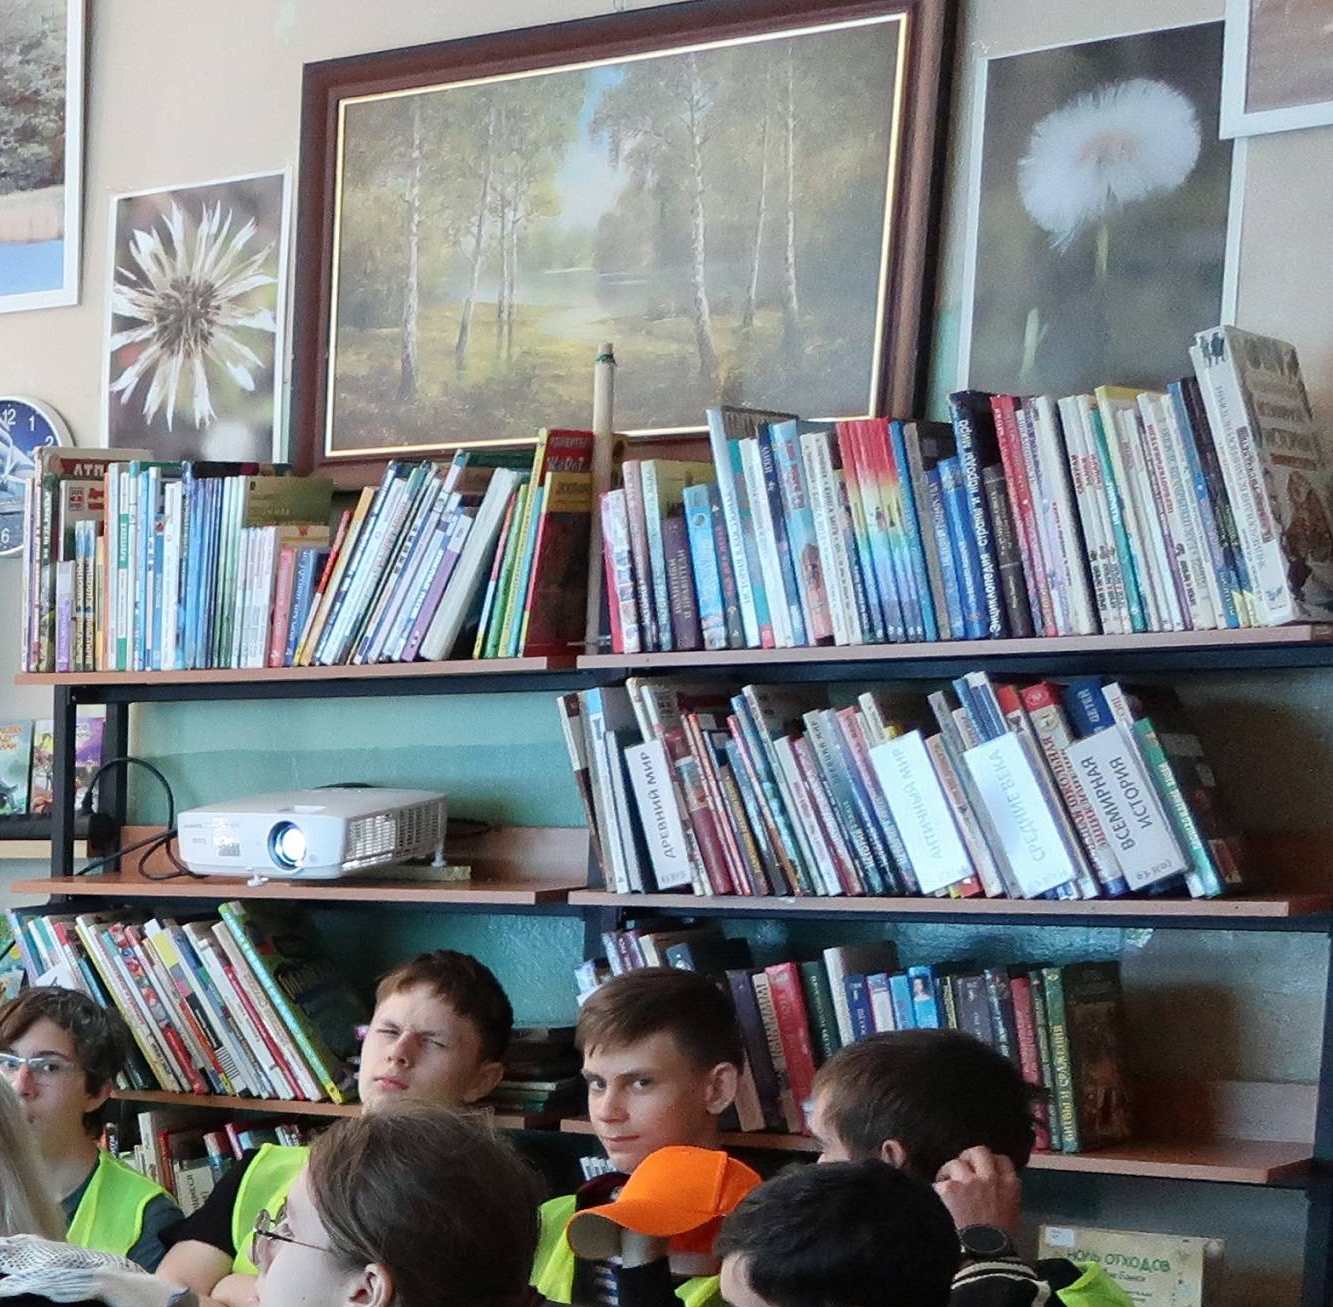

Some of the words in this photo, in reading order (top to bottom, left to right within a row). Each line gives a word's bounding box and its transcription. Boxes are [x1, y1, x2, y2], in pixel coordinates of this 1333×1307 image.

[2, 408, 17, 426] 12
[28, 415, 35, 431] 1
[959, 418, 973, 450] мира
[963, 452, 980, 494] народы
[971, 496, 981, 505] и
[1, 527, 11, 543] 6
[973, 510, 989, 546] страны
[980, 553, 1002, 634] Энциклопедия
[639, 751, 658, 788] МИР
[891, 747, 912, 775] МИР
[988, 748, 1015, 792] ВЕКА
[1080, 755, 1137, 851] ВСЕМИРНАЯ
[1109, 757, 1153, 829] ИСТОРИЯ
[648, 791, 677, 860] ДРЕВНИЙ
[900, 776, 943, 860] АНТИЧНЫЙ
[1005, 792, 1046, 862] СРЕДНИЕ
[1053, 1024, 1071, 1088] СРАЖЕНИЯ
[1060, 1101, 1077, 1143] БИТВЫ
[1104, 1252, 1171, 1274] ОТХОДОВ
